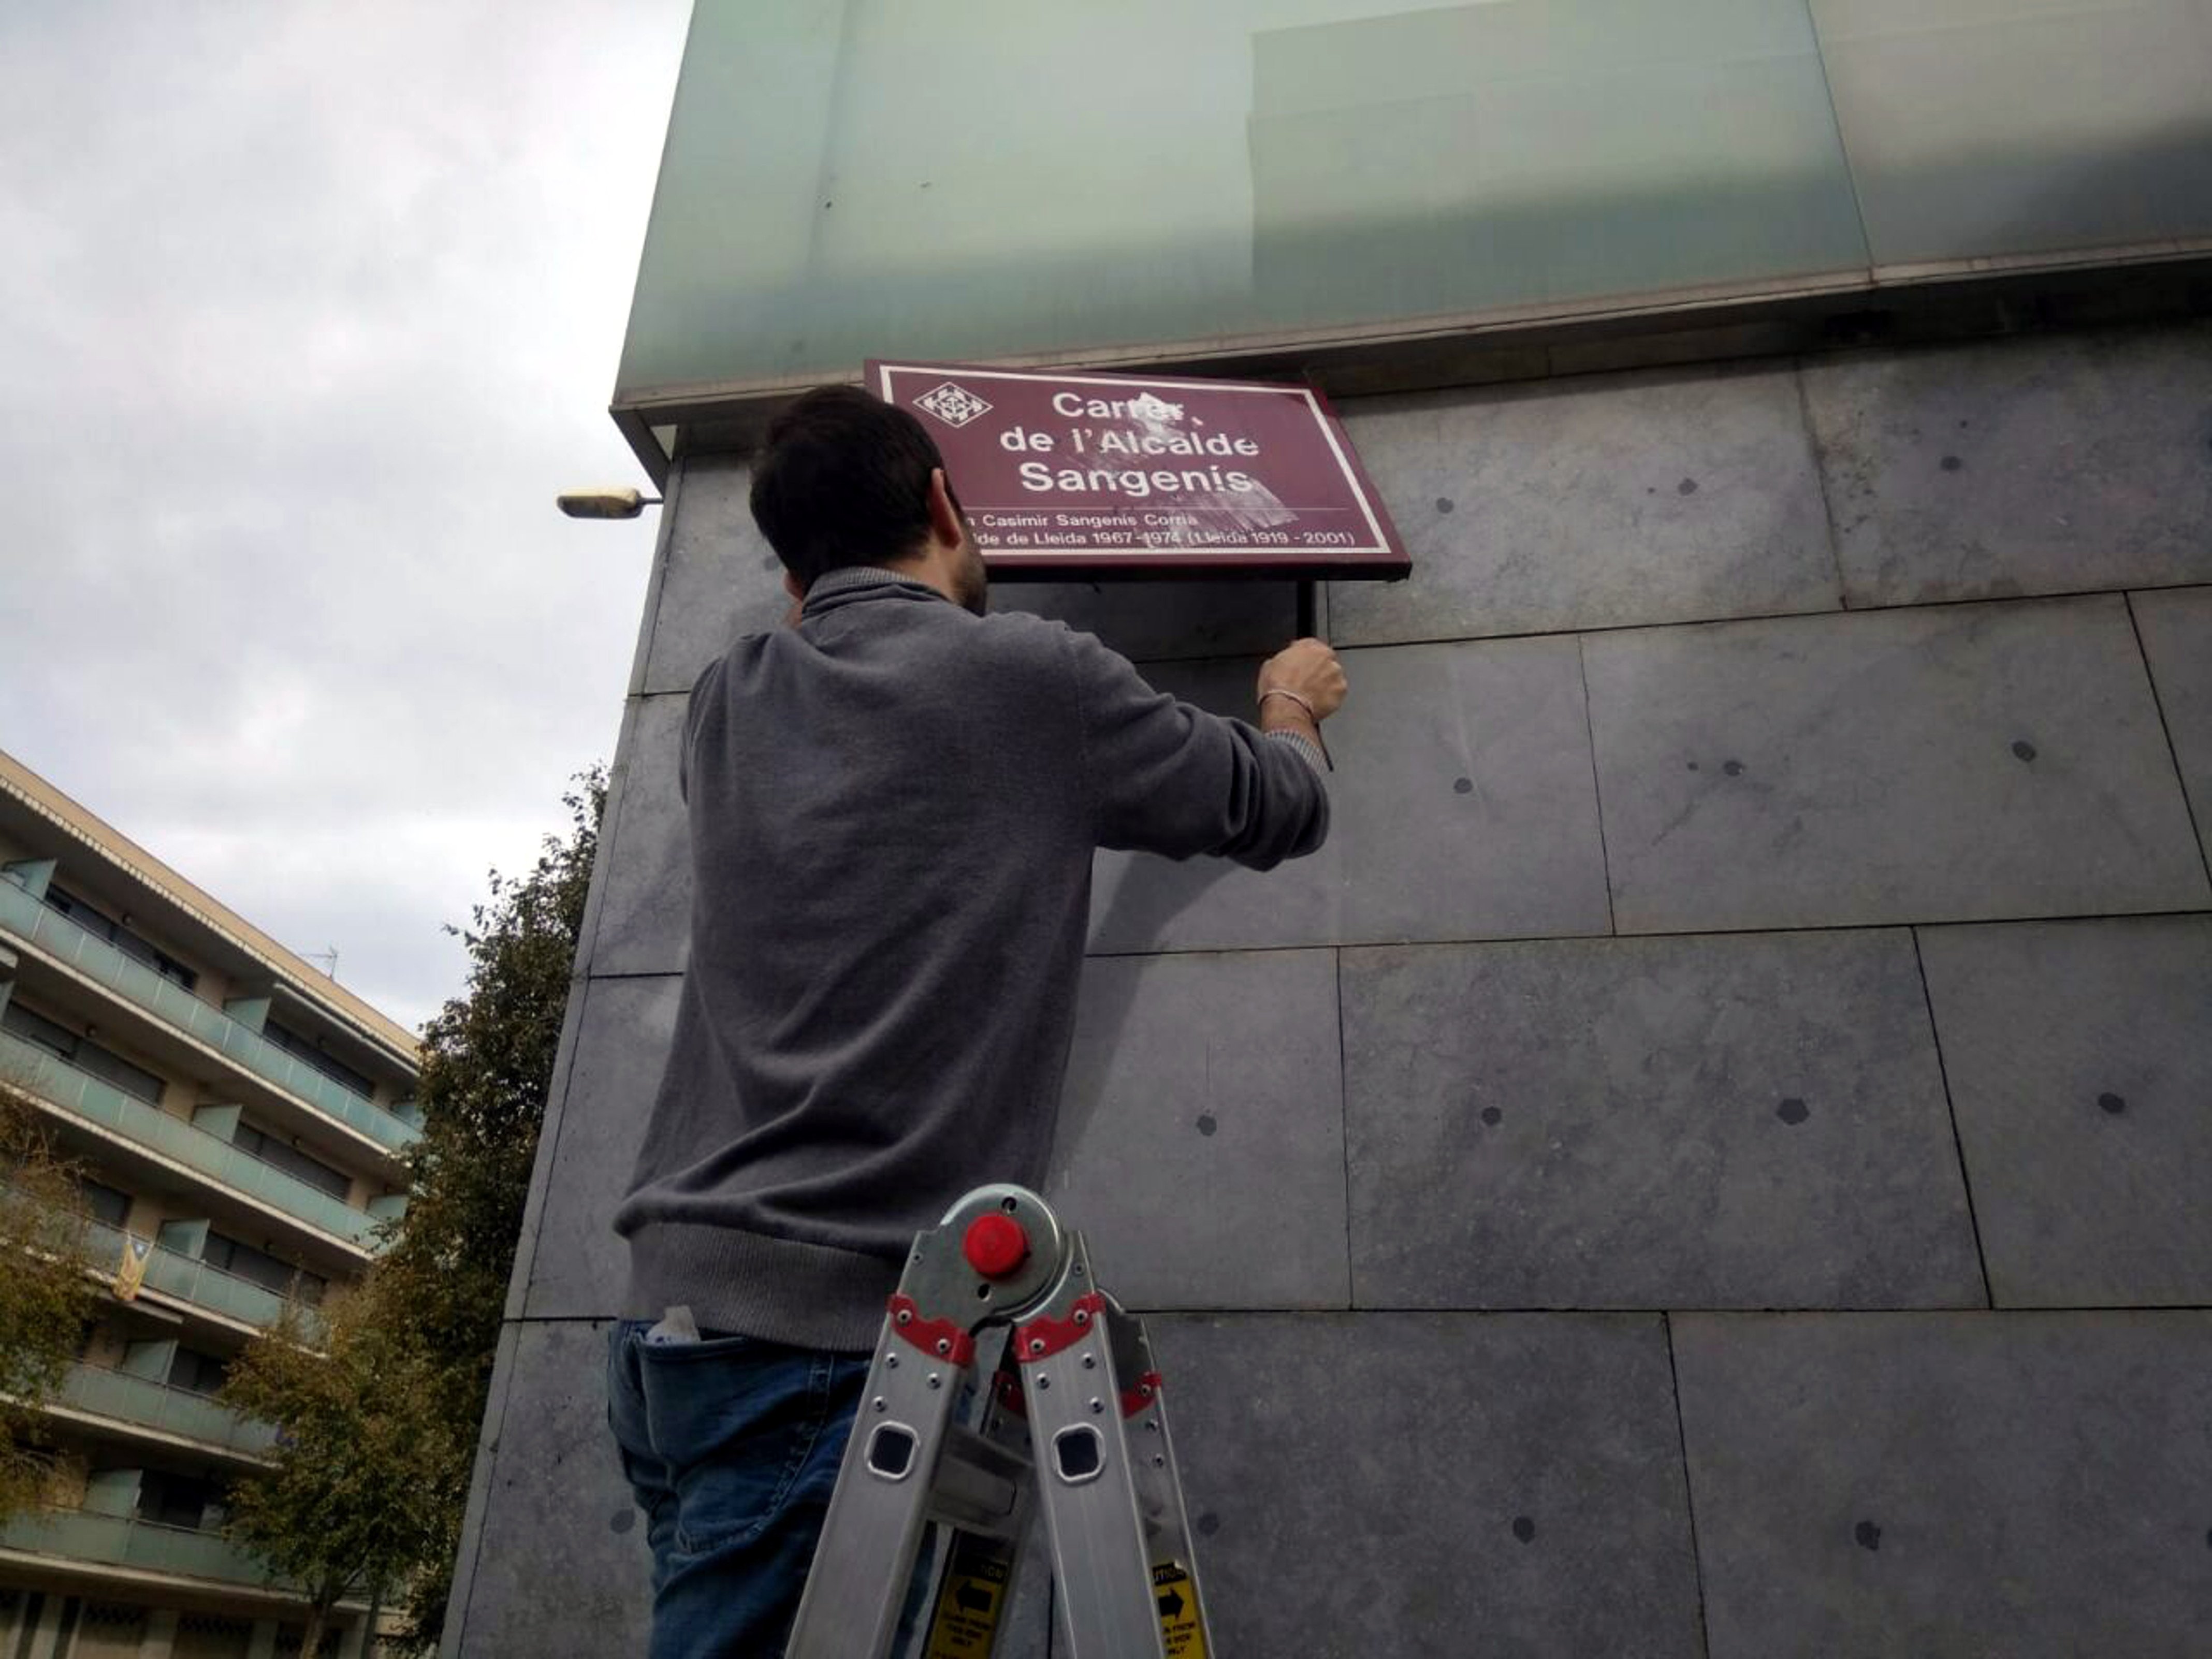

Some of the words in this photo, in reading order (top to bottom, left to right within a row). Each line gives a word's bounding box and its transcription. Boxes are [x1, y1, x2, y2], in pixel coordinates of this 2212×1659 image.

[1000, 426, 1054, 452] de
[1071, 428, 1259, 456] l'Alcalde
[983, 514, 1048, 526] Casimir
[1006, 532, 1029, 545] de
[1035, 532, 1086, 545] Lleida
[1251, 531, 1288, 544] 1919
